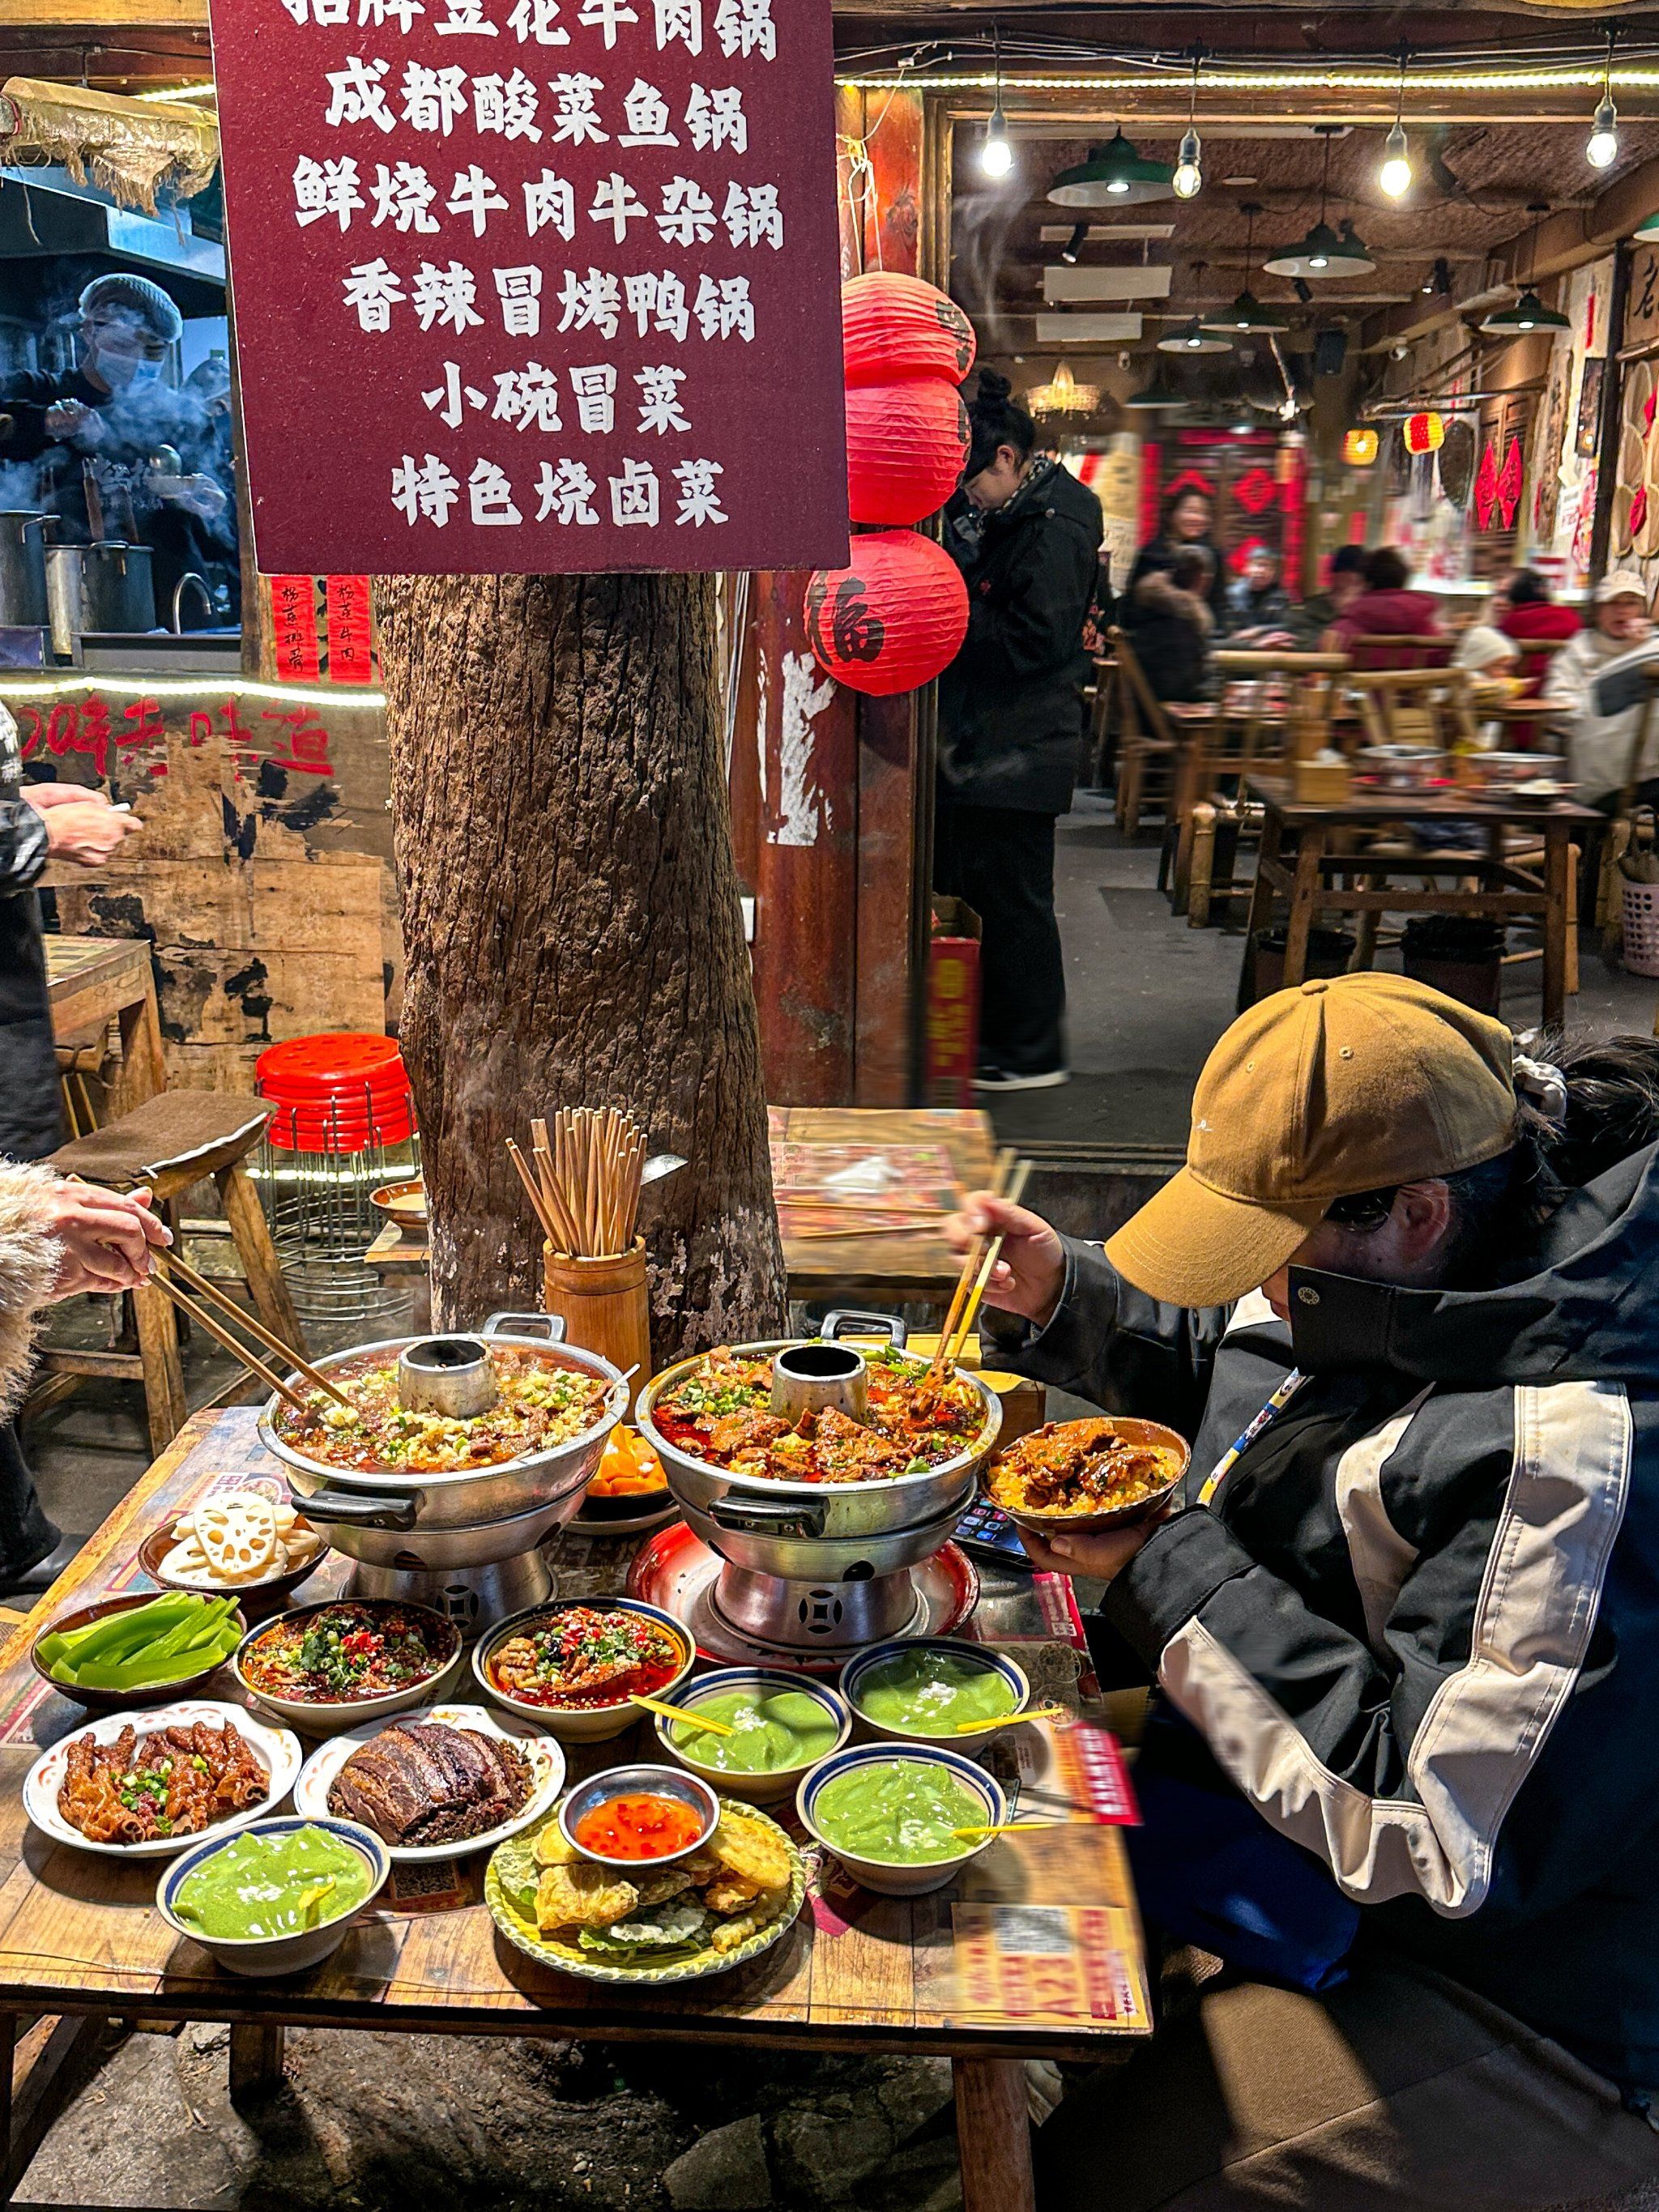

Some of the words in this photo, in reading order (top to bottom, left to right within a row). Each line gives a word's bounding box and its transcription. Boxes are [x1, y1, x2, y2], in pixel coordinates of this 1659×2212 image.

[325, 55, 748, 155] 成都酸菜鱼锅
[292, 154, 783, 251] 鲜烧牛肉牛杂锅
[341, 255, 755, 343] 香辣冒烤鸭锅
[420, 360, 692, 436] 小碗冒菜
[390, 453, 729, 528] 特色烧卤菜
